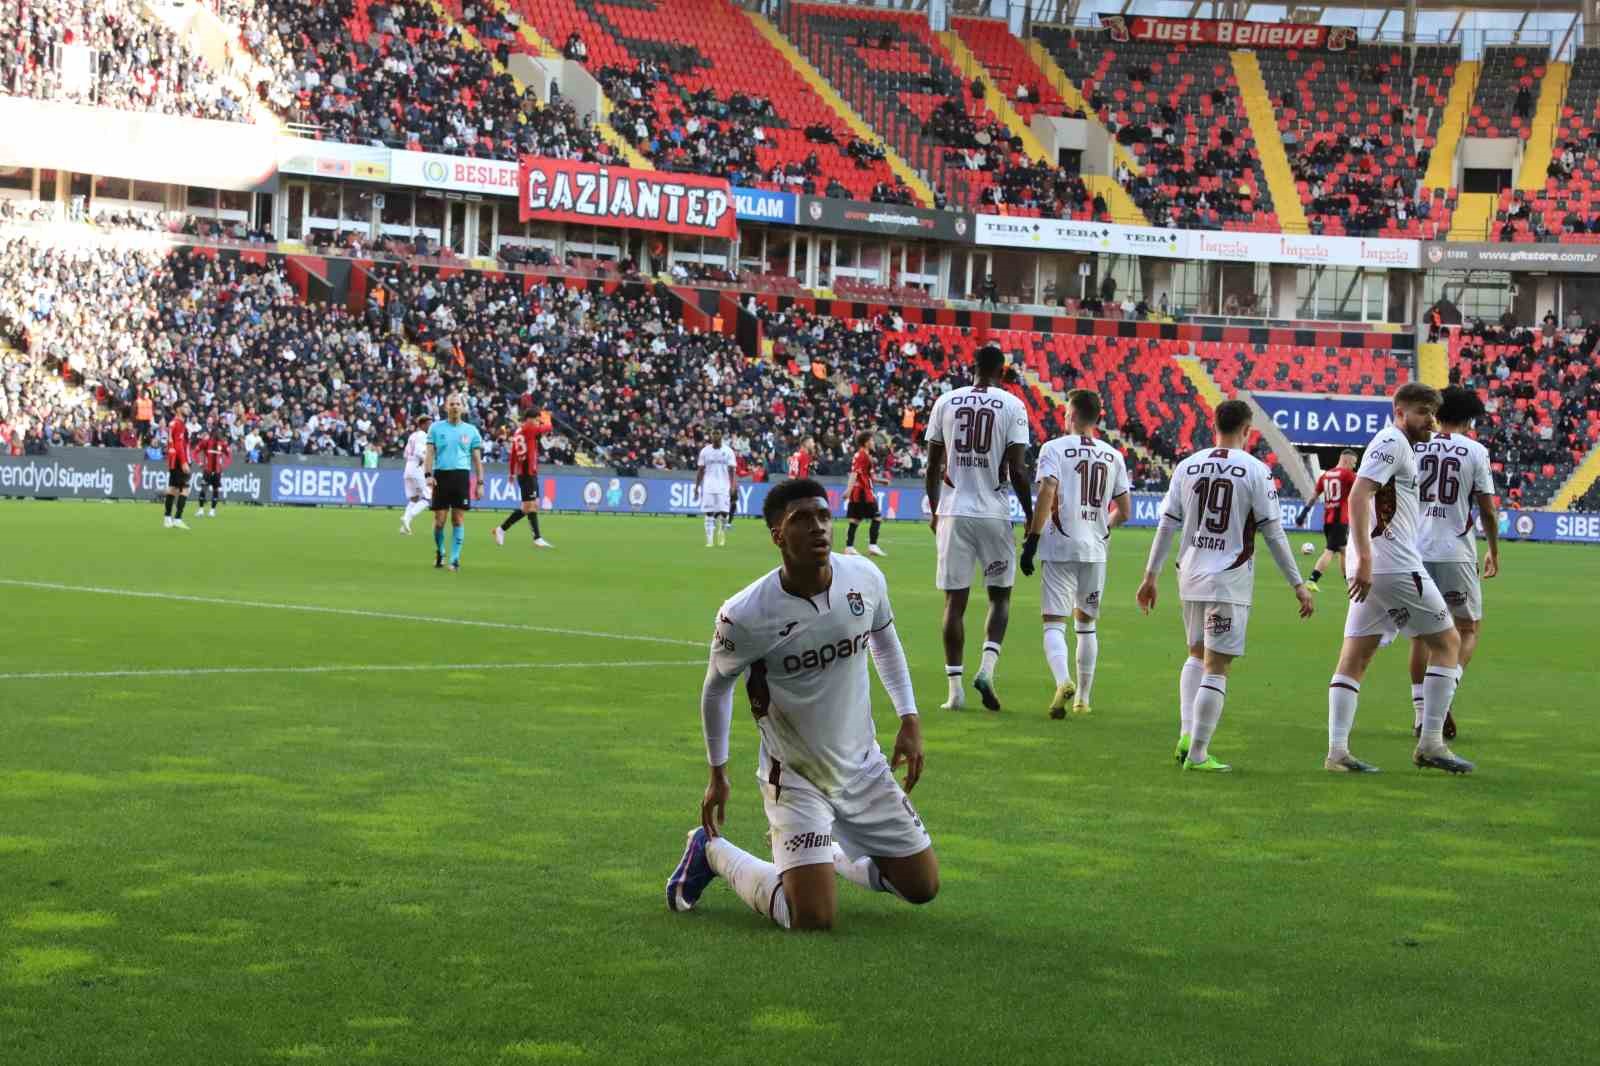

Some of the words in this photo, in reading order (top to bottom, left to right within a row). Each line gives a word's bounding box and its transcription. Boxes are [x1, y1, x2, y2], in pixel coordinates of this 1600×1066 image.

[1137, 18, 1204, 41] Just
[1216, 22, 1319, 45] Believe
[528, 168, 729, 228] GAZİANTEP
[985, 222, 1030, 233] TEBA
[1056, 227, 1099, 238] TEBA
[1125, 233, 1167, 243] TEBA
[954, 406, 995, 454] 30
[1074, 459, 1108, 508] 10
[1324, 478, 1341, 501] 10
[1420, 454, 1461, 505] 26
[1192, 476, 1233, 534] 19
